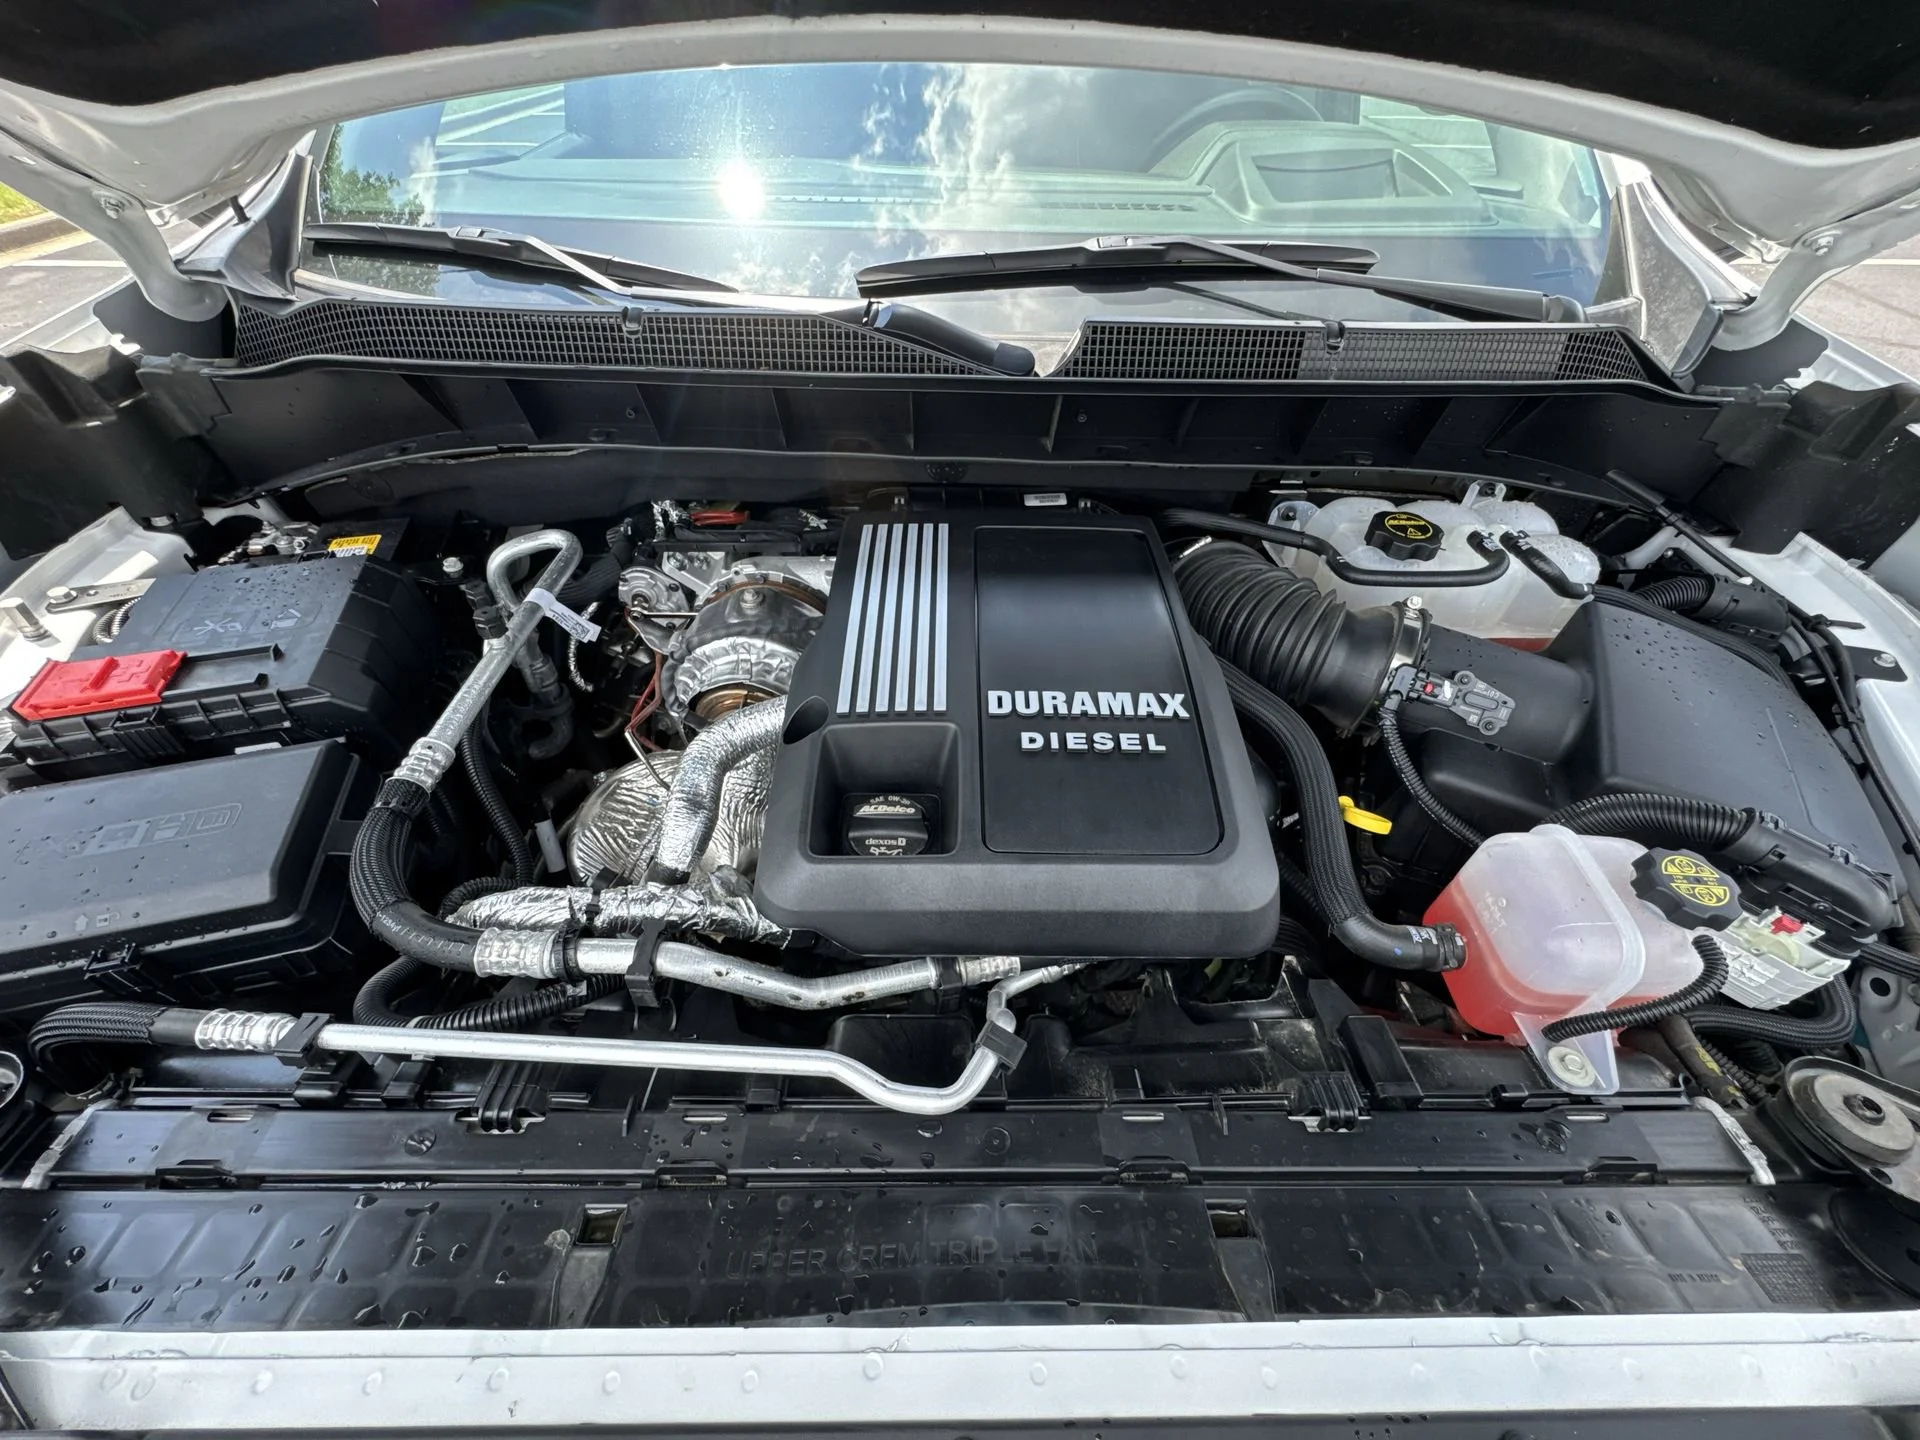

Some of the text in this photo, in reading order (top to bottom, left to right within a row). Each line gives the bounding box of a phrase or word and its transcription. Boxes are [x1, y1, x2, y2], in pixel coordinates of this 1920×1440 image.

[987, 690, 1190, 720] DURAMAX
[1020, 731, 1167, 753] DIESEL
[856, 804, 916, 815] ACDelco
[869, 795, 885, 805] SAE
[726, 1248, 828, 1280] UPPER
[930, 1234, 1035, 1265] TRIPLE
[1042, 1238, 1100, 1265] FAN
